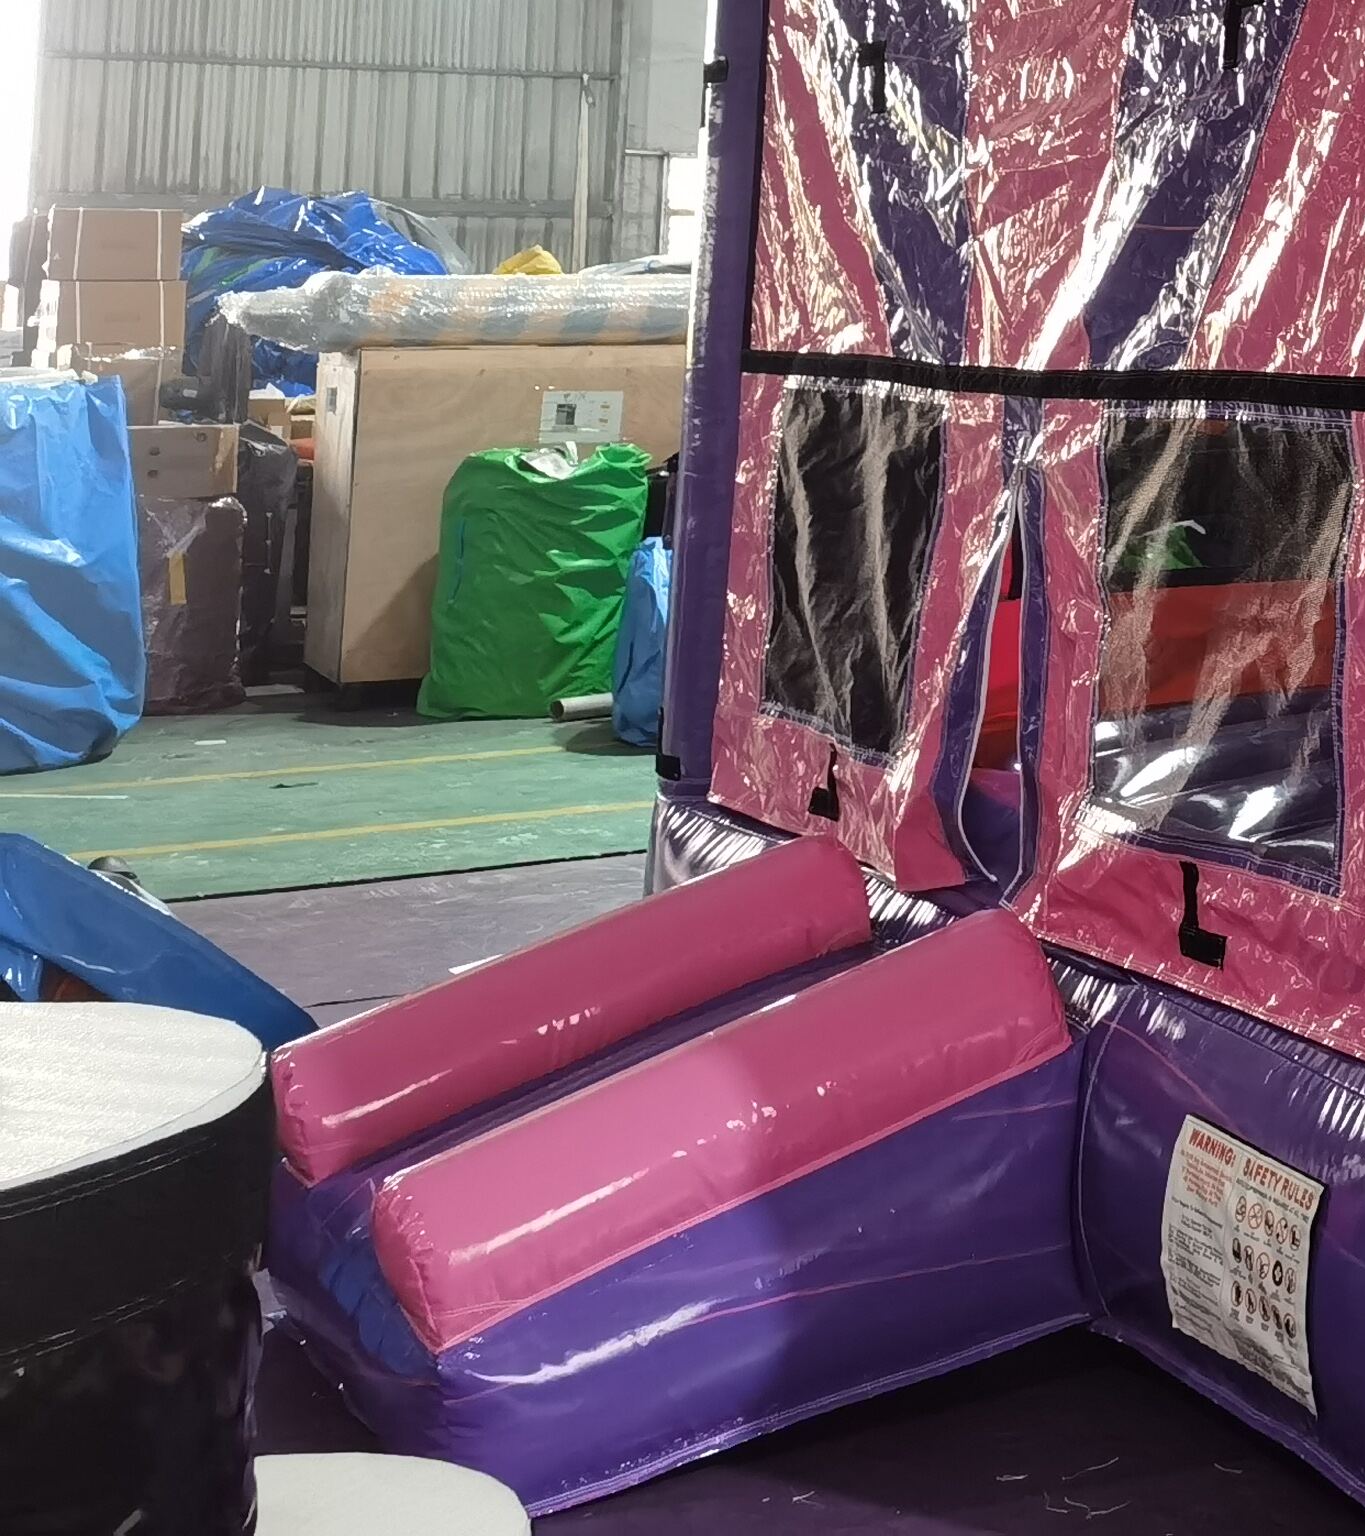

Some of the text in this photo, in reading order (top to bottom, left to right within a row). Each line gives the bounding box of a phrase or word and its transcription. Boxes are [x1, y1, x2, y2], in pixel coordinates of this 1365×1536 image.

[1188, 1128, 1237, 1168] WARNING:
[1243, 1158, 1283, 1192] SAFETY
[1281, 1178, 1314, 1211] RULES
